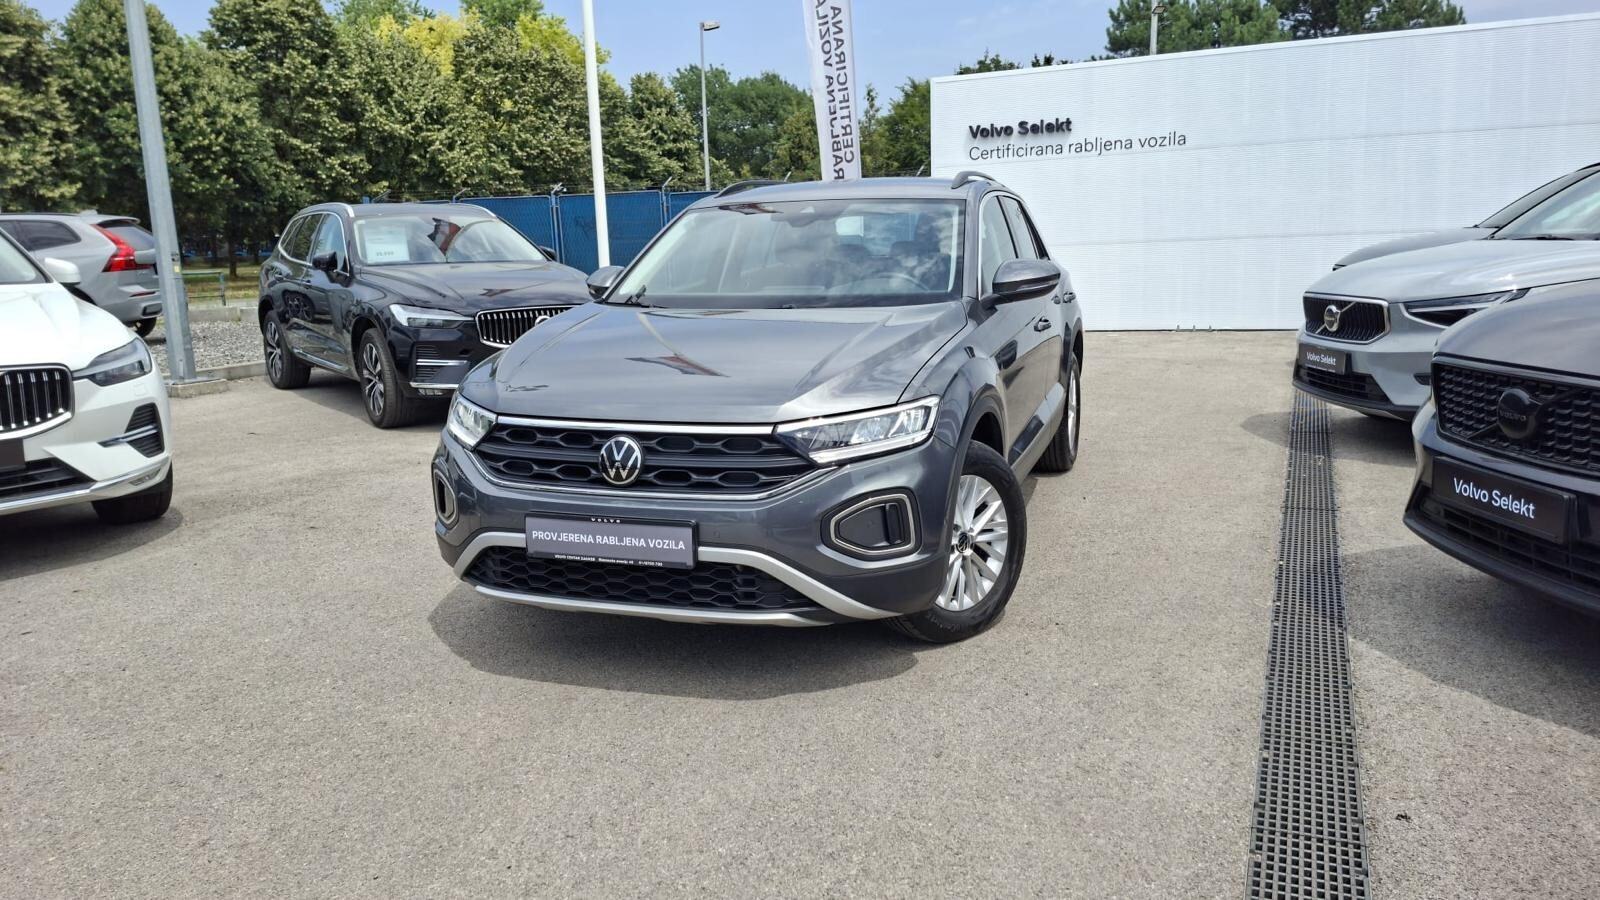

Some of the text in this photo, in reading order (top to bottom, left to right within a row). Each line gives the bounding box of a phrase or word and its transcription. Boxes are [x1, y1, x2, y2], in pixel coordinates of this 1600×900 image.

[969, 117, 1073, 139] Volvo Selekt
[968, 131, 1187, 161] Certificirana rabljena vozila
[1306, 351, 1337, 366] Volvo Selekt
[1453, 477, 1535, 519] Volvo Selekt
[532, 530, 686, 550] PROVJERENA RABLJENA VOZILA
